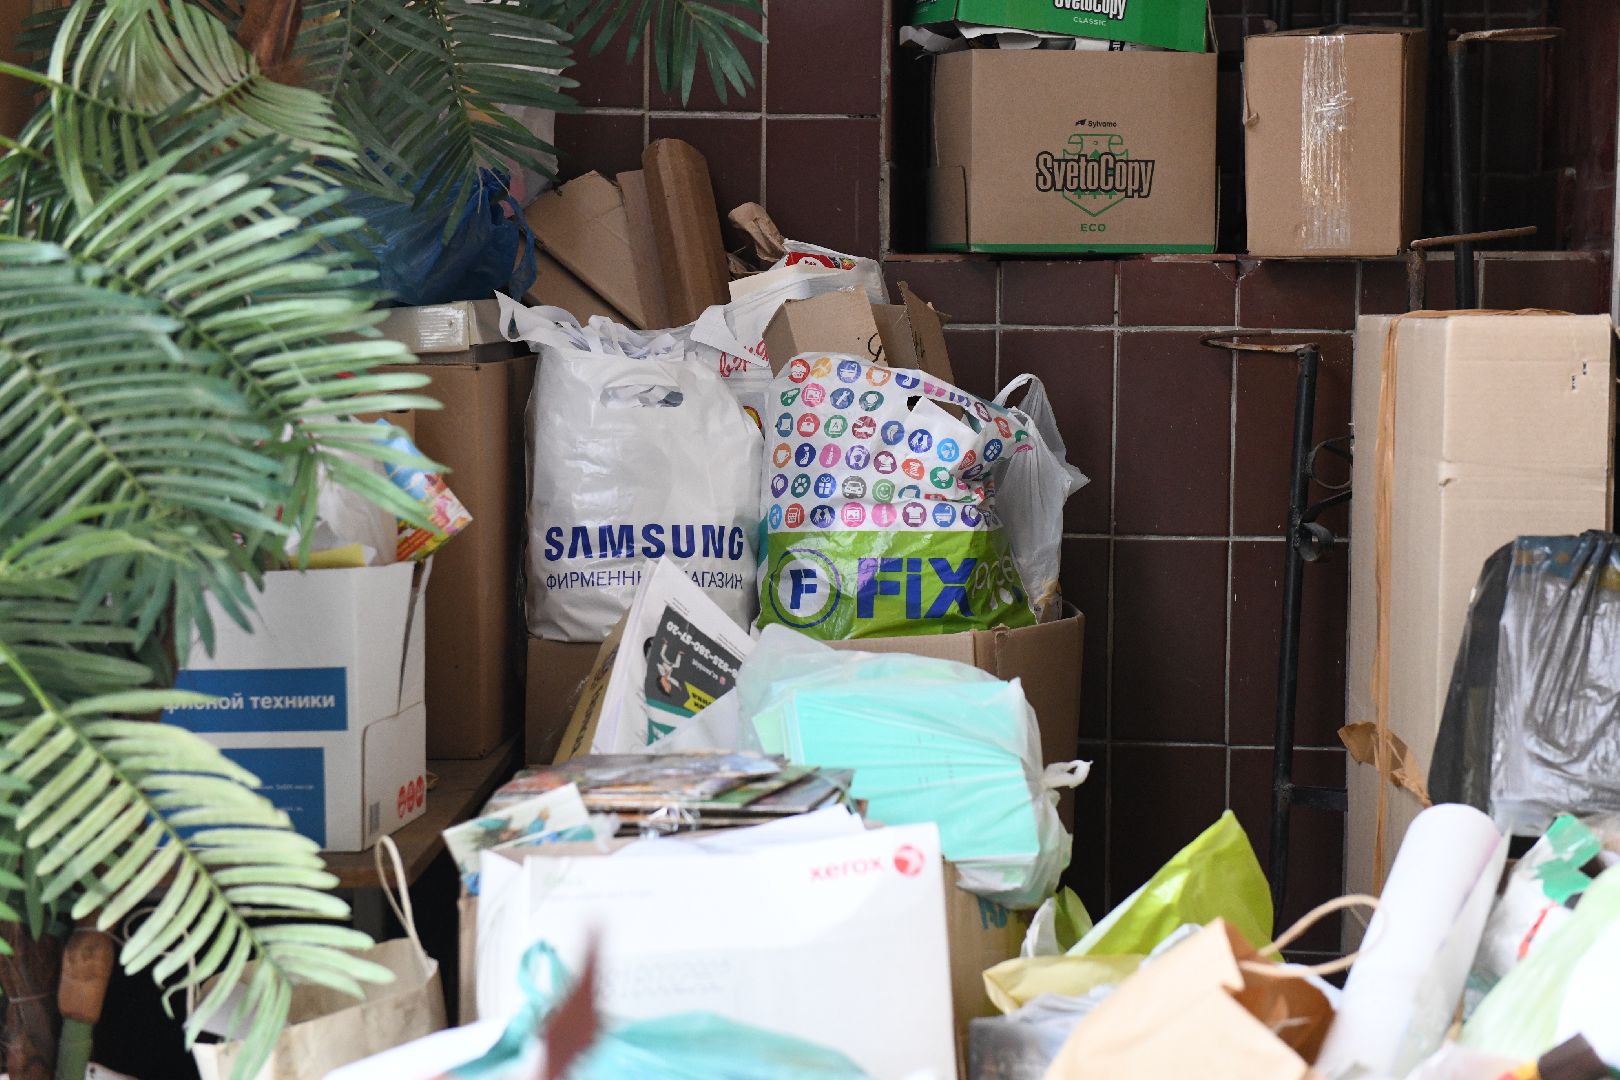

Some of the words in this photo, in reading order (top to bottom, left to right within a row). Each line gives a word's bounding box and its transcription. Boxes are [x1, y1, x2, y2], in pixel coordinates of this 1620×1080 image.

[1073, 16, 1107, 26] CLASSIC
[1088, 119, 1118, 129] Sylvamo
[1036, 150, 1155, 198] SvetoCopy
[1080, 223, 1106, 232] ECO
[545, 523, 744, 562] SAMSUNG
[685, 570, 743, 590] АГАЗИН
[248, 694, 336, 710] техники
[809, 857, 884, 882] xerox
